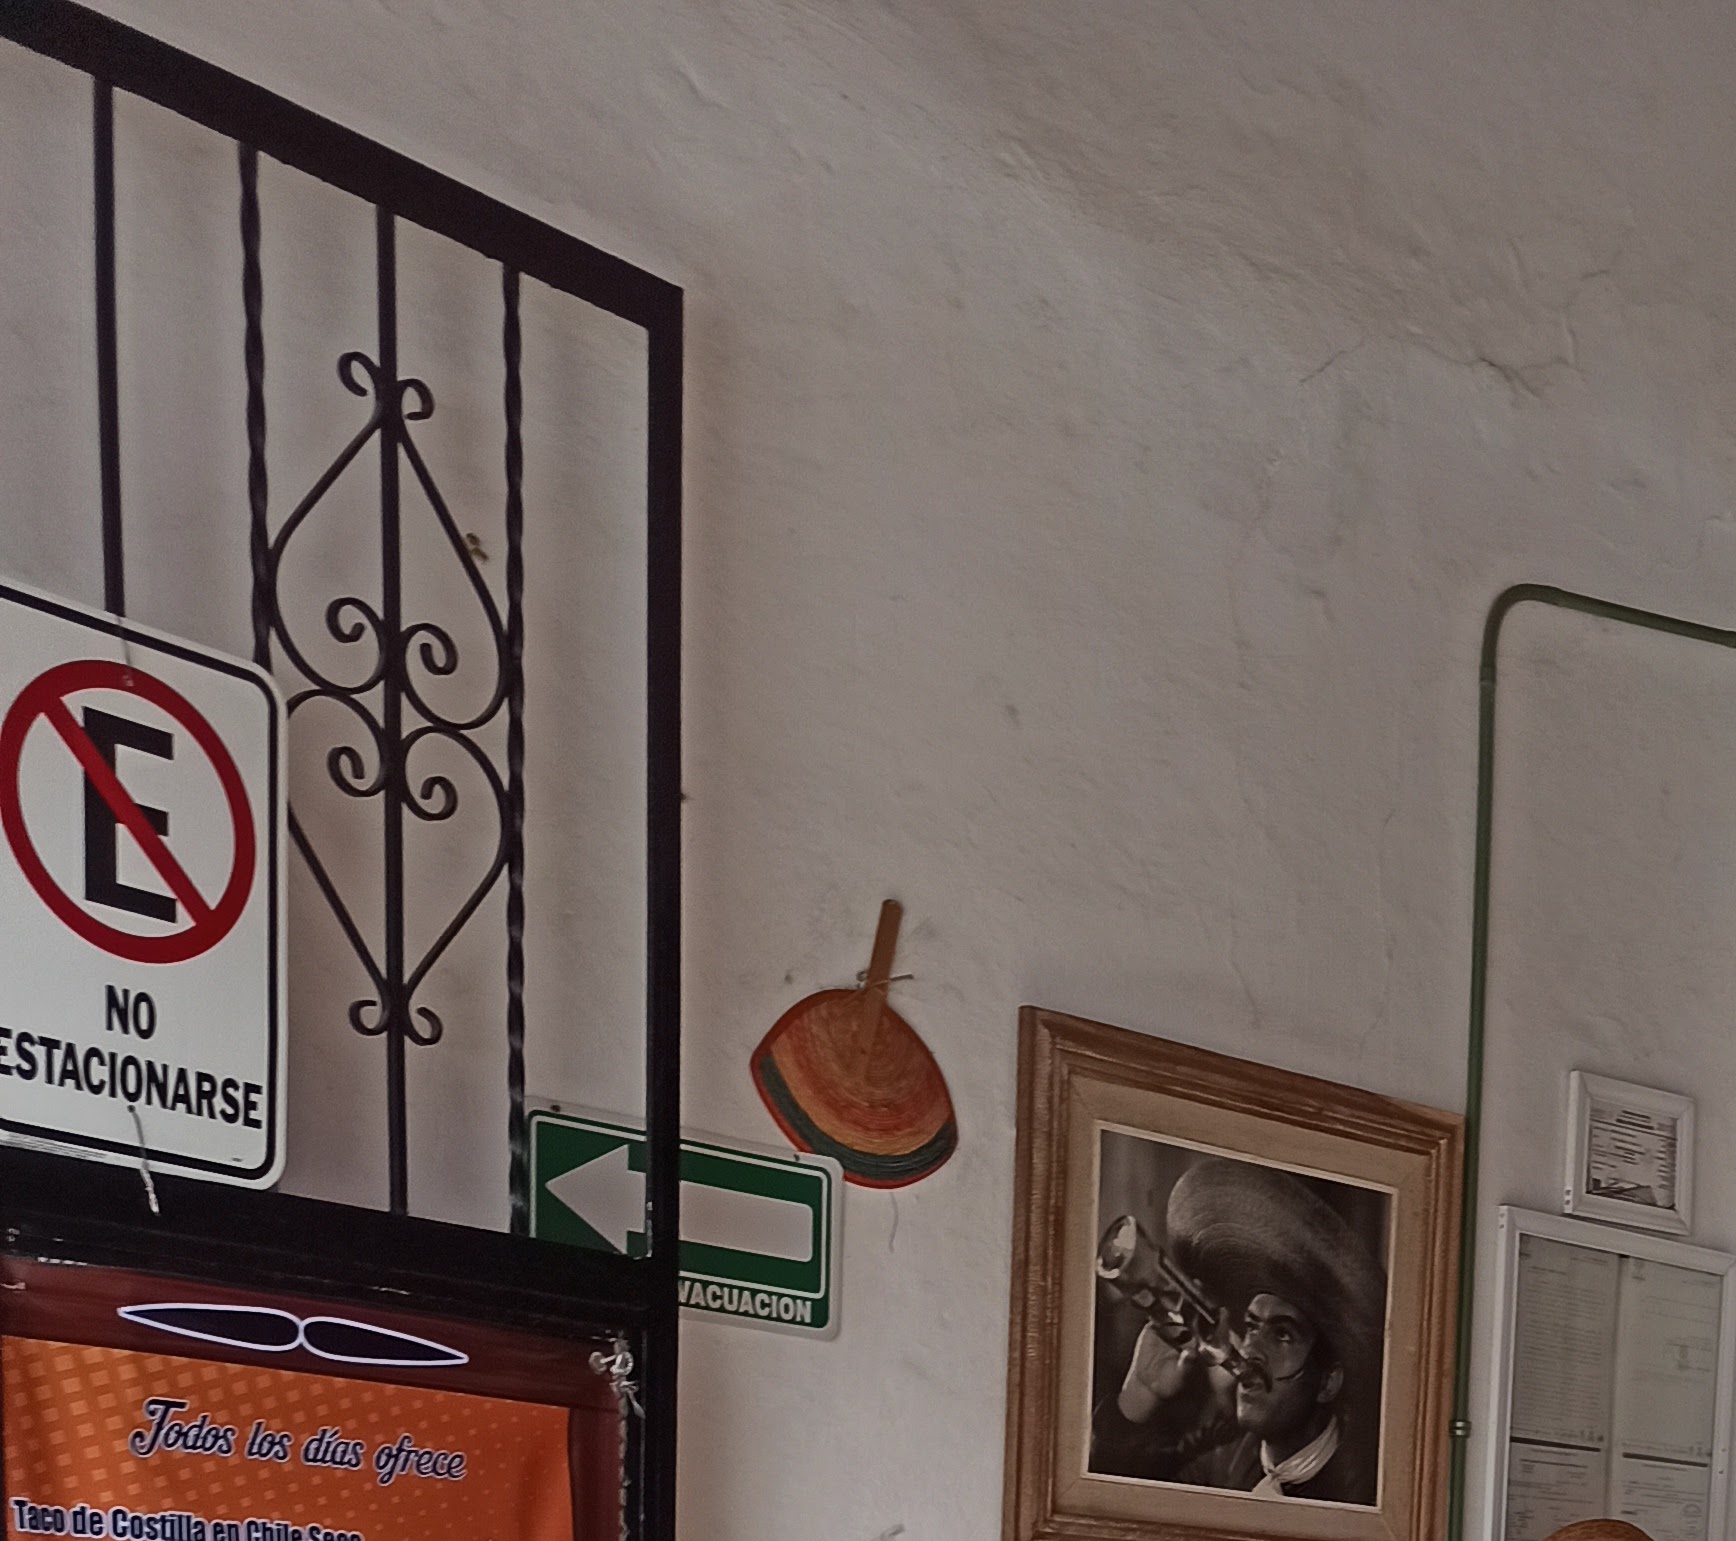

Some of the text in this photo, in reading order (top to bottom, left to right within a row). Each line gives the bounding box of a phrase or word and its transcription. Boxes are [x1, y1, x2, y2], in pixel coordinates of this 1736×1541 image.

[104, 984, 157, 1040] NO
[678, 1279, 812, 1323] VACUACION
[130, 1398, 466, 1486] Todos los días ofrece
[14, 1499, 65, 1533] Taco
[72, 1505, 104, 1537] de
